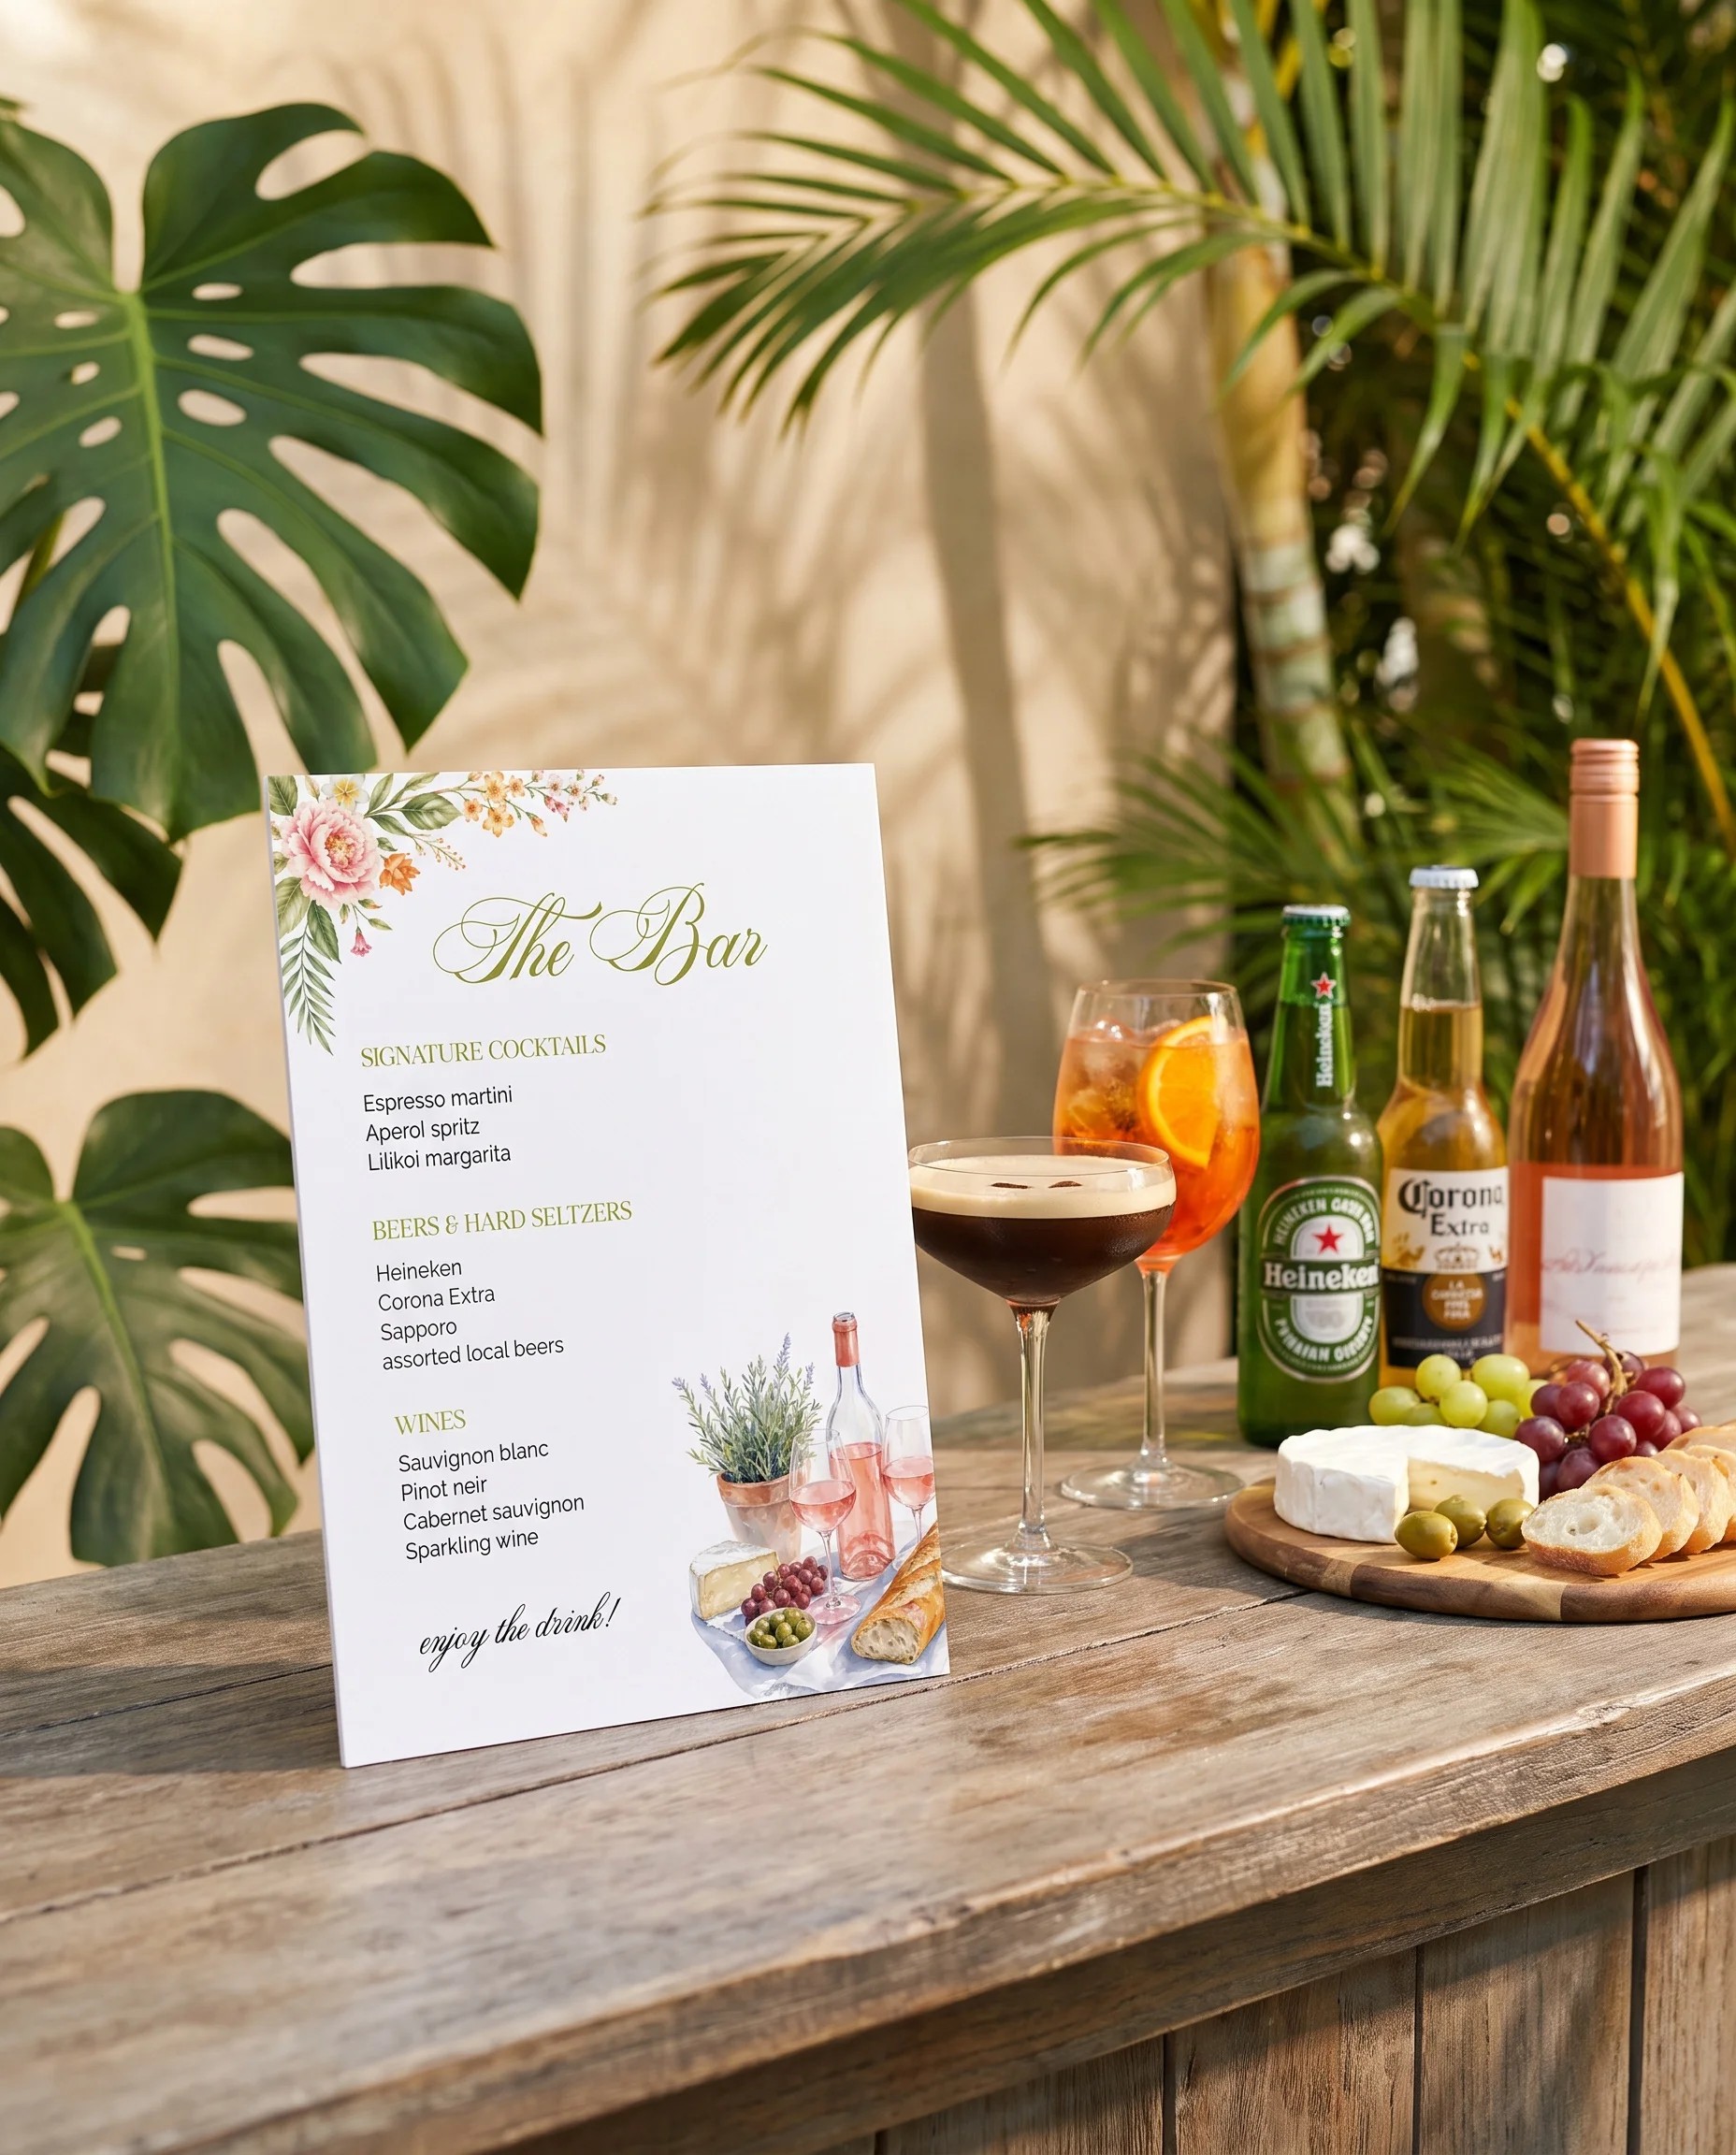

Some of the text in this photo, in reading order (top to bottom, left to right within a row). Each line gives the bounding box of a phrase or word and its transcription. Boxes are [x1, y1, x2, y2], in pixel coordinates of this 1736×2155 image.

[432, 882, 768, 986] The Bar
[361, 1034, 606, 1067] SIGNATURE COCKTAILS
[364, 1084, 513, 1115] Espresso martini
[366, 1117, 480, 1146] Aperol spritz
[368, 1145, 511, 1171] Lilikoi margarita
[1398, 1178, 1504, 1219] Corona
[372, 1200, 632, 1240] BEERS & HARD SELTZERS
[1430, 1213, 1490, 1237] Extra
[376, 1260, 462, 1282] Heineken
[1264, 1260, 1380, 1290] Heineken
[378, 1286, 495, 1311] Corona Extra
[381, 1320, 457, 1343] Sapporo
[383, 1338, 564, 1370] assorted local beers
[395, 1409, 466, 1436] WINES
[398, 1441, 549, 1472] Sauvignon blanc
[401, 1475, 487, 1501] Pinot neir
[403, 1495, 585, 1530] Cabernet sauvignon
[406, 1529, 539, 1564] Sparkling wine
[420, 1592, 621, 1672] enjoy the drink!
